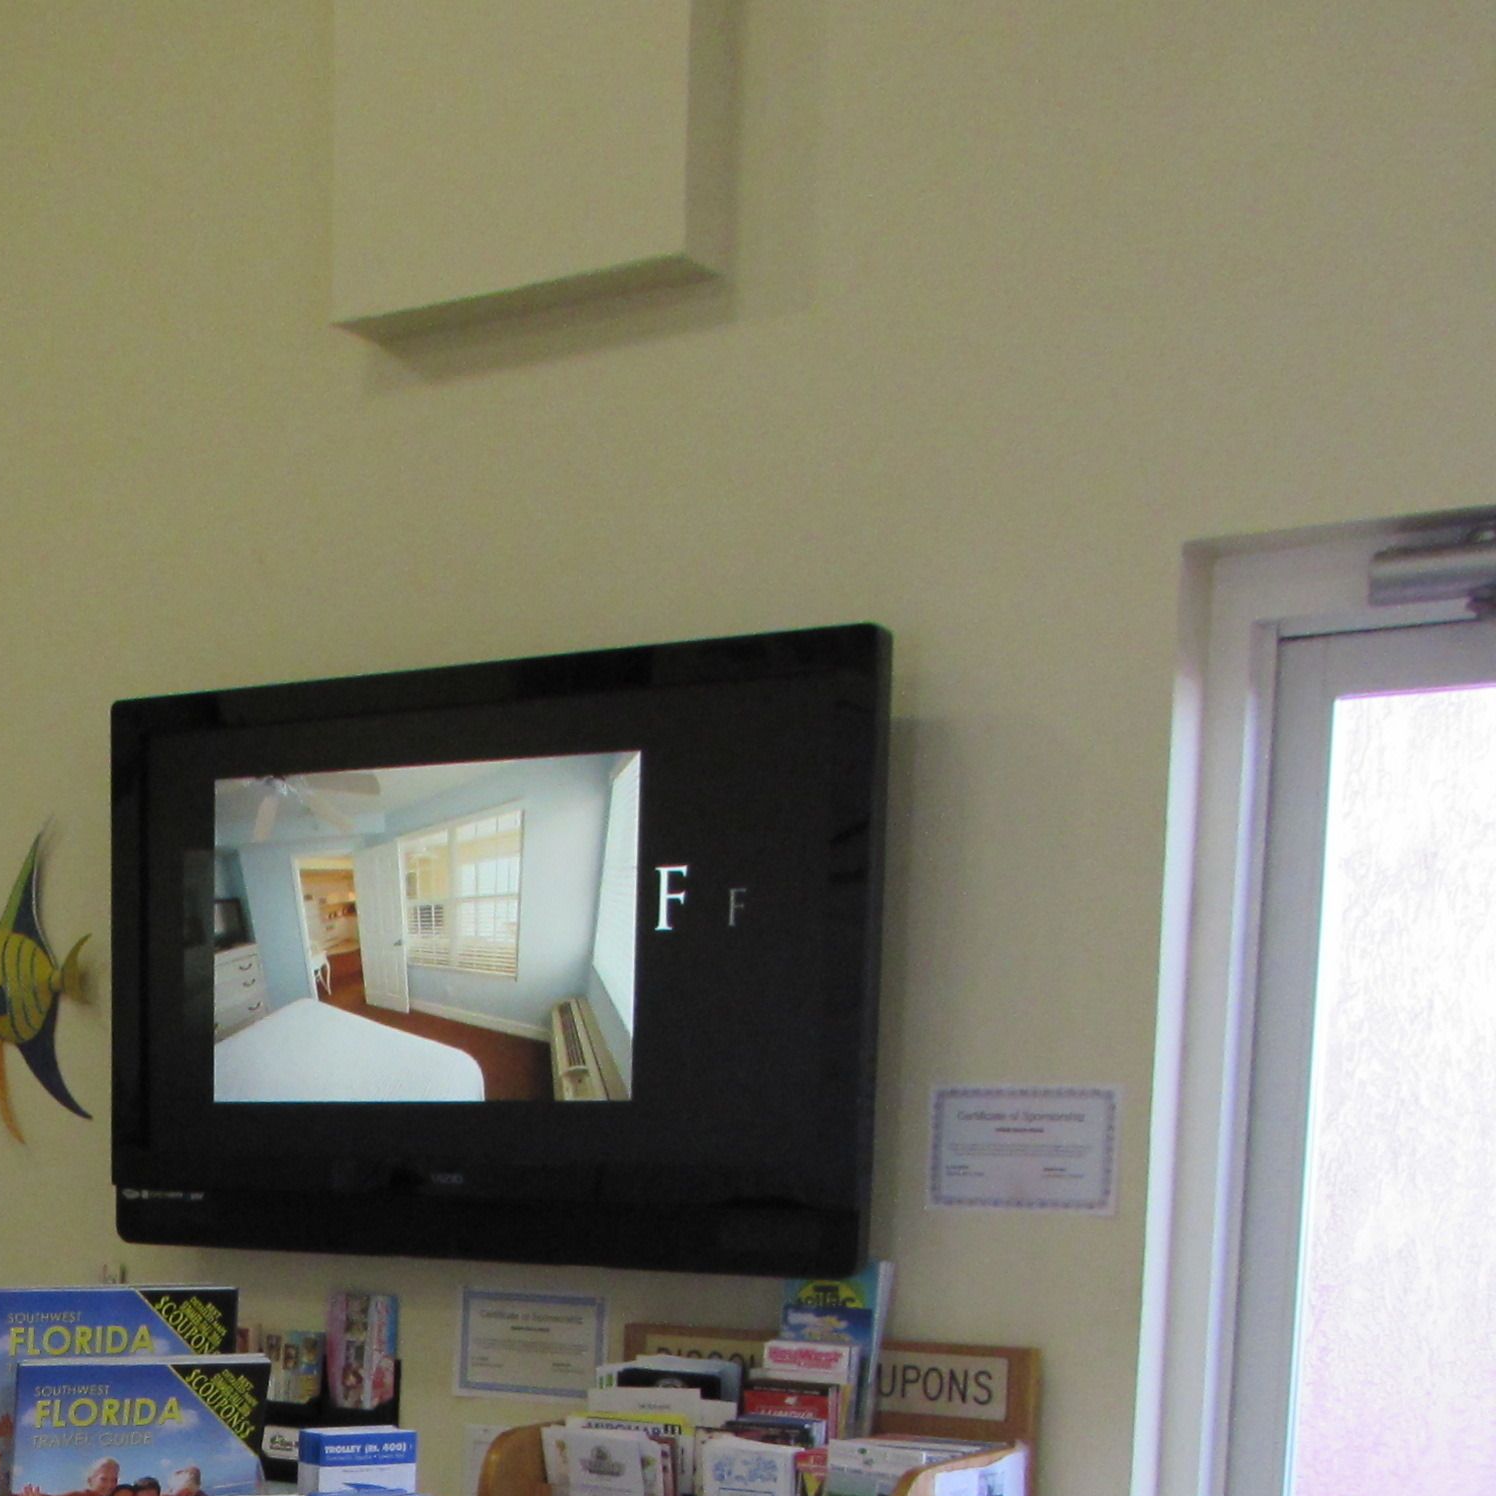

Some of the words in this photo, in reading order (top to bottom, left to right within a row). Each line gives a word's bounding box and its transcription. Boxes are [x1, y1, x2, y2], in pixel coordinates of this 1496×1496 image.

[655, 864, 688, 931] F
[727, 887, 747, 927] F
[7, 1311, 82, 1324] SOUTHWEST
[8, 1324, 155, 1357] FLORIDA
[33, 1384, 110, 1398] SOUTHWEST
[878, 1363, 993, 1405] UPONS
[33, 1396, 184, 1429] FLORIDA
[99, 1431, 153, 1447] GUIDE
[324, 1444, 362, 1455] TROLLEY
